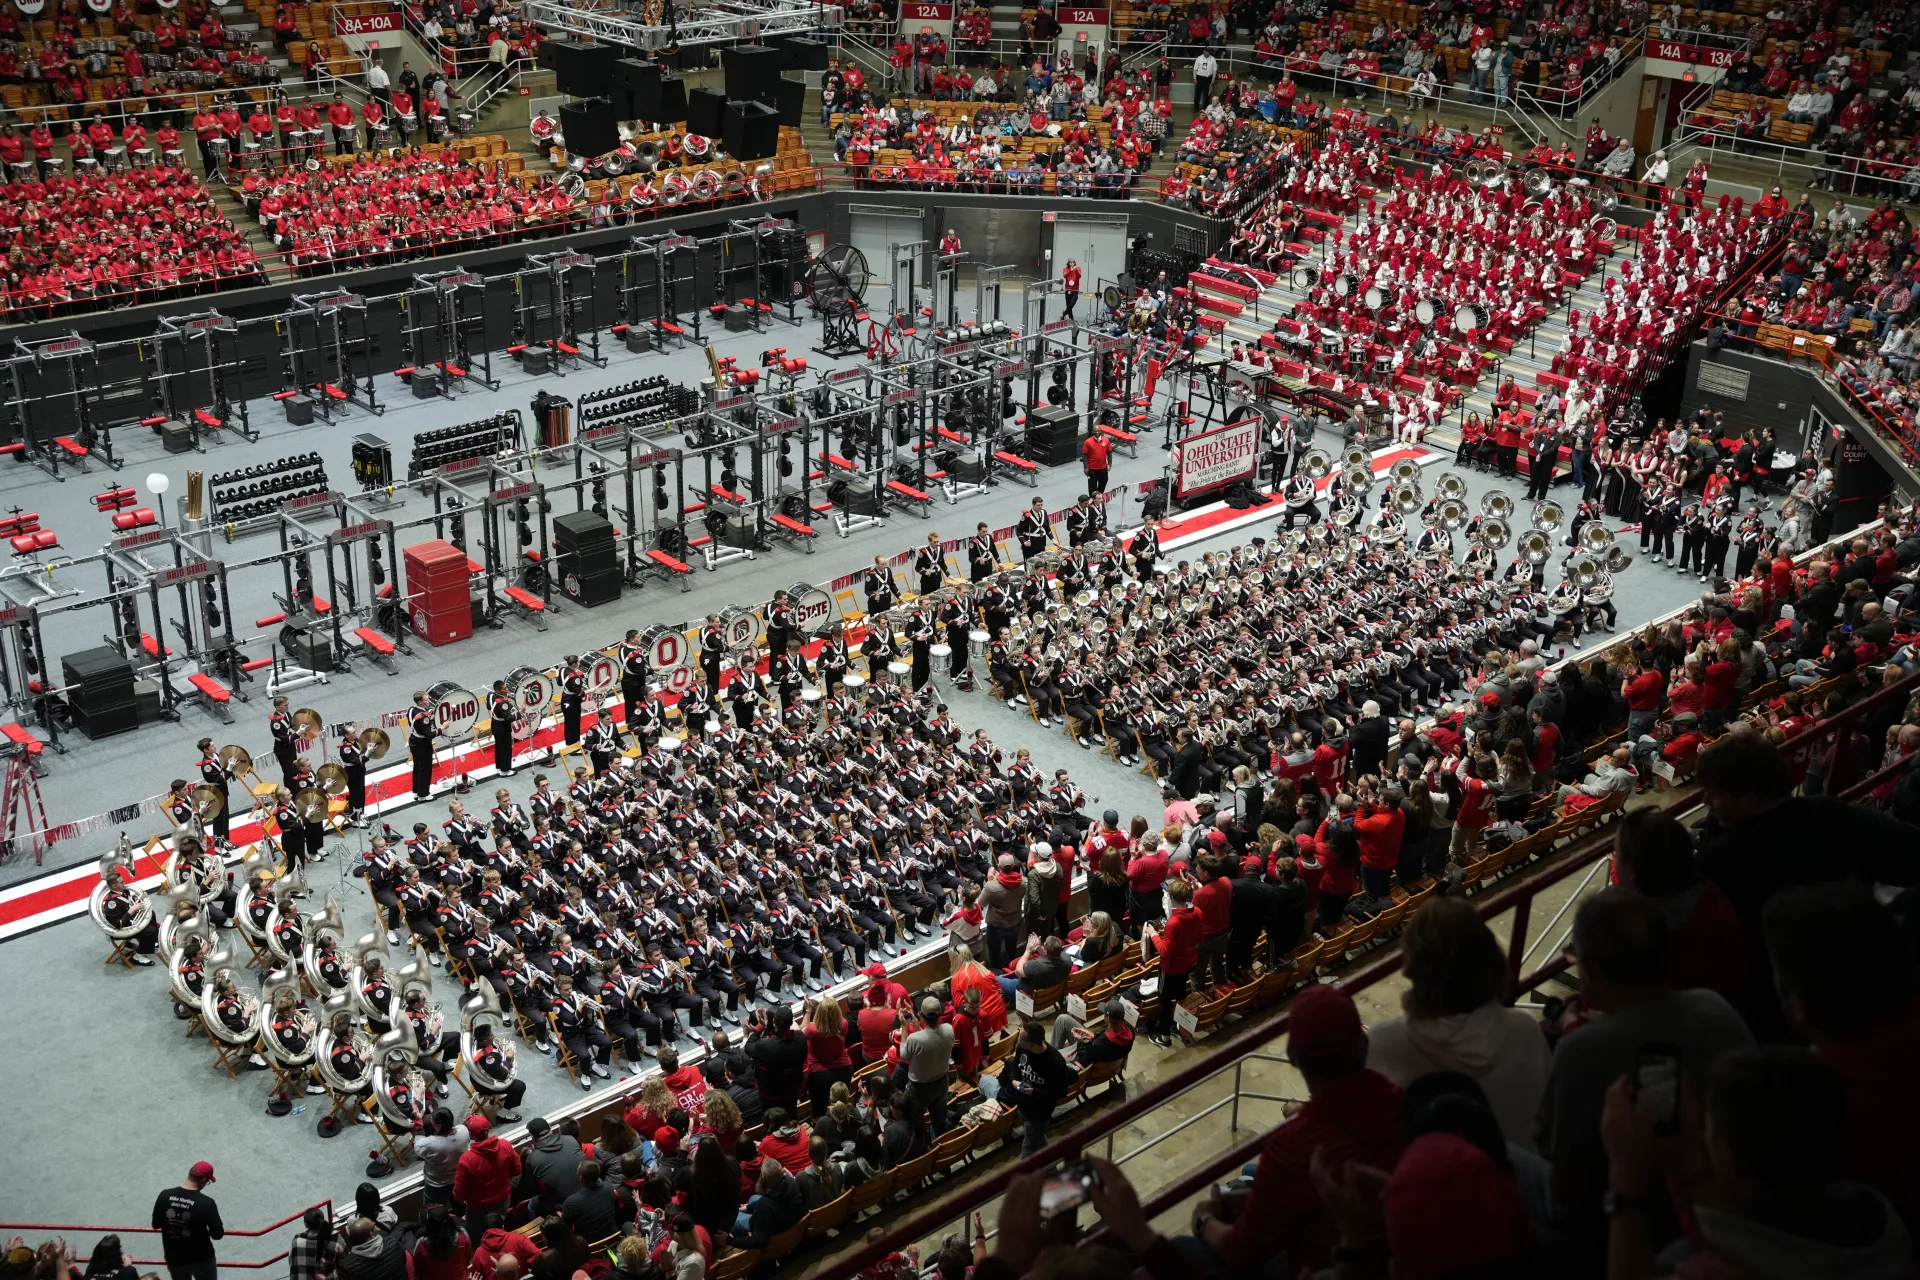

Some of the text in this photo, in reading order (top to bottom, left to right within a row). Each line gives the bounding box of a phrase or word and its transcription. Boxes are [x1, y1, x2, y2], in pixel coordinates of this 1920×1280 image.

[917, 6, 939, 17] 12A
[1072, 11, 1094, 22] 12A
[345, 16, 392, 32] 8A-10A
[1659, 44, 1680, 58] 14A
[1710, 51, 1732, 66] 13A
[208, 317, 224, 326] STATE
[47, 340, 80, 352] OHIO STATE
[1188, 431, 1252, 461] OHIO STATE
[446, 456, 479, 472] OHIO STATE
[640, 450, 669, 464] OHIO STATE
[1185, 443, 1253, 474] UNIVERSITY
[1197, 460, 1239, 477] MARCHING BAND
[496, 484, 530, 499] OHIO STATE
[292, 492, 328, 508] OHIO STATE
[341, 522, 377, 538] OHIO STATE
[120, 531, 160, 548] OHIO STATE
[167, 562, 207, 580] OHIO STATE
[0, 608, 17, 621] TATE
[798, 601, 828, 622] STATE
[658, 637, 678, 666] O
[595, 662, 611, 687] O
[439, 700, 475, 725] OHIO
[1330, 756, 1346, 779] 11
[973, 1026, 979, 1047] 1
[678, 1091, 704, 1109] Ohio
